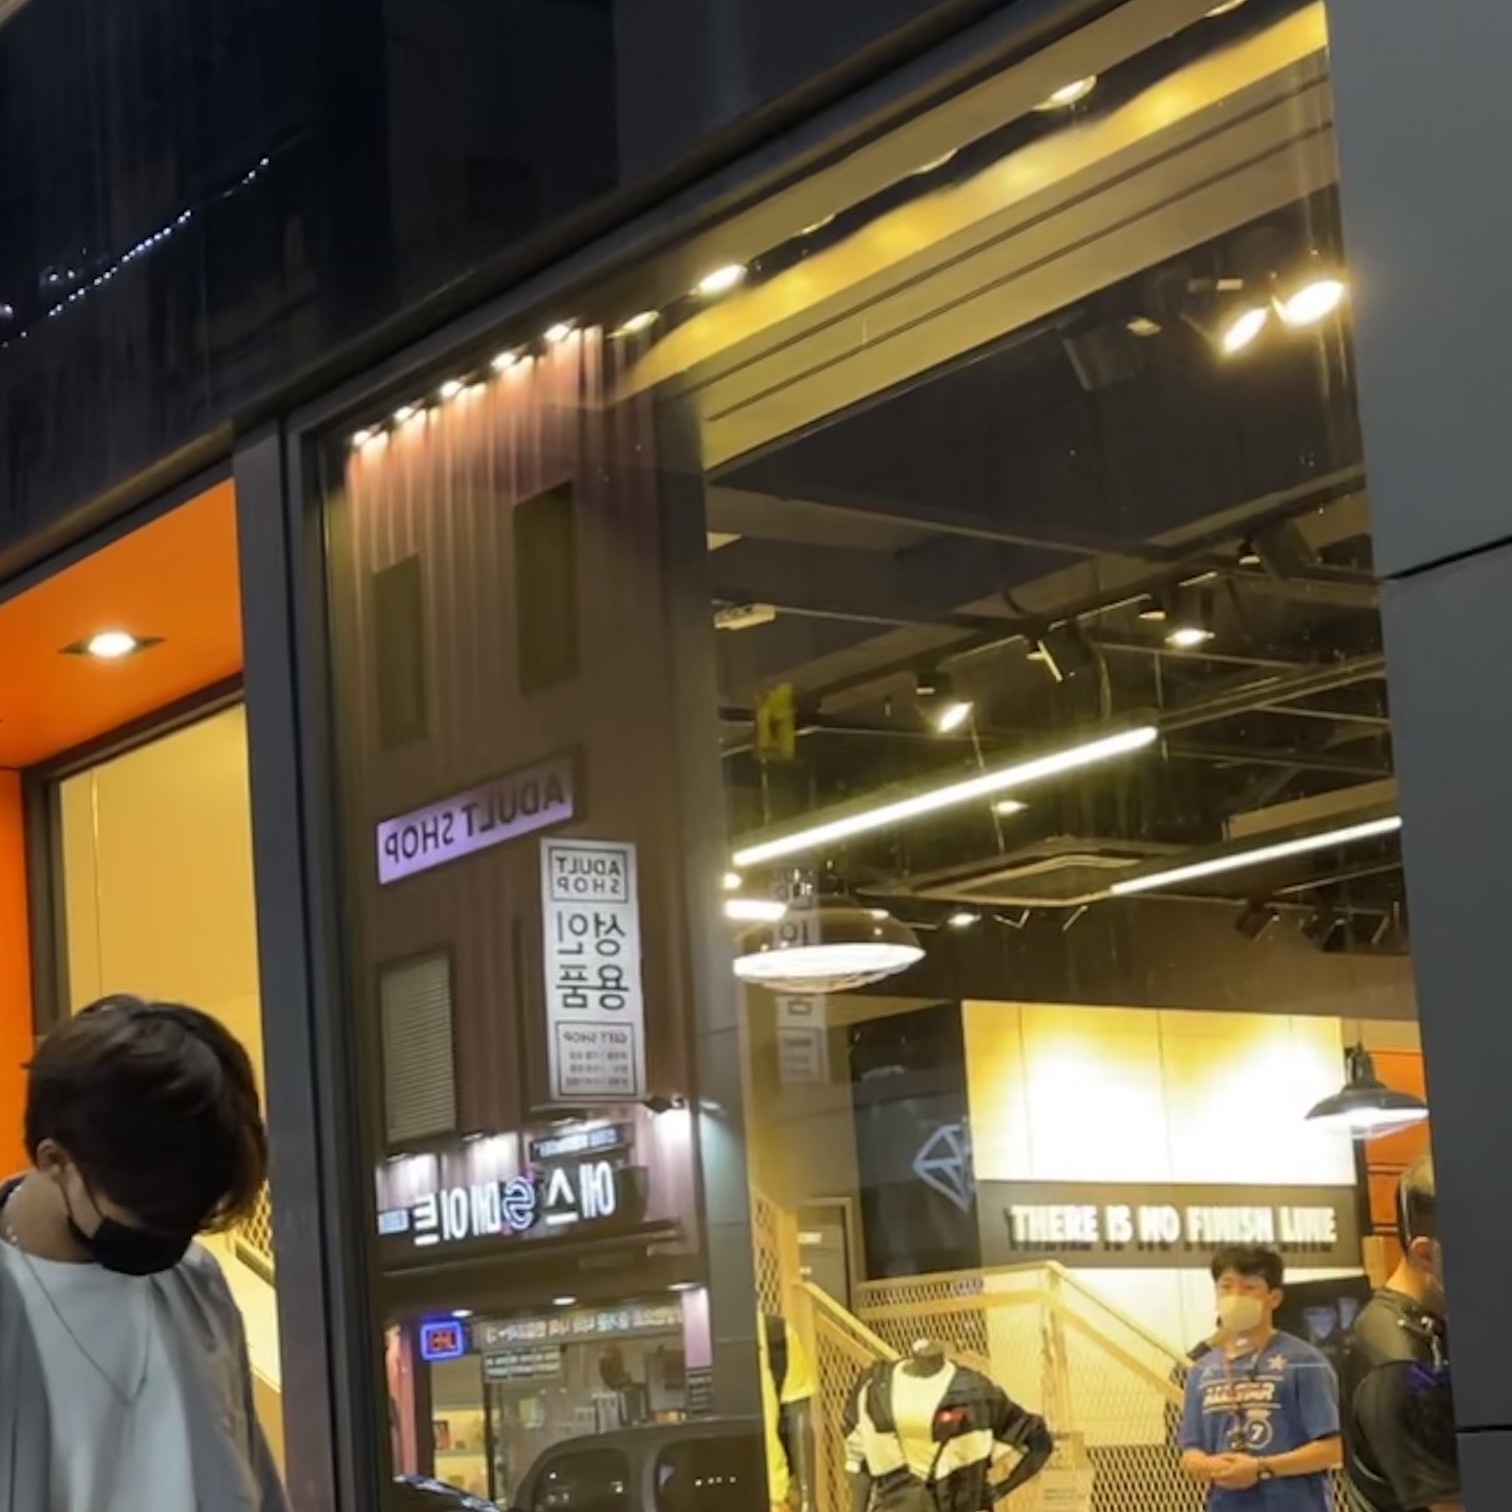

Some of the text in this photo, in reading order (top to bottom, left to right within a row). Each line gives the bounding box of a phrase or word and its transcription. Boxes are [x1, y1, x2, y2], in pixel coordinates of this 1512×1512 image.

[1007, 1203, 1338, 1248] THERE IS NO FINISH LINE
